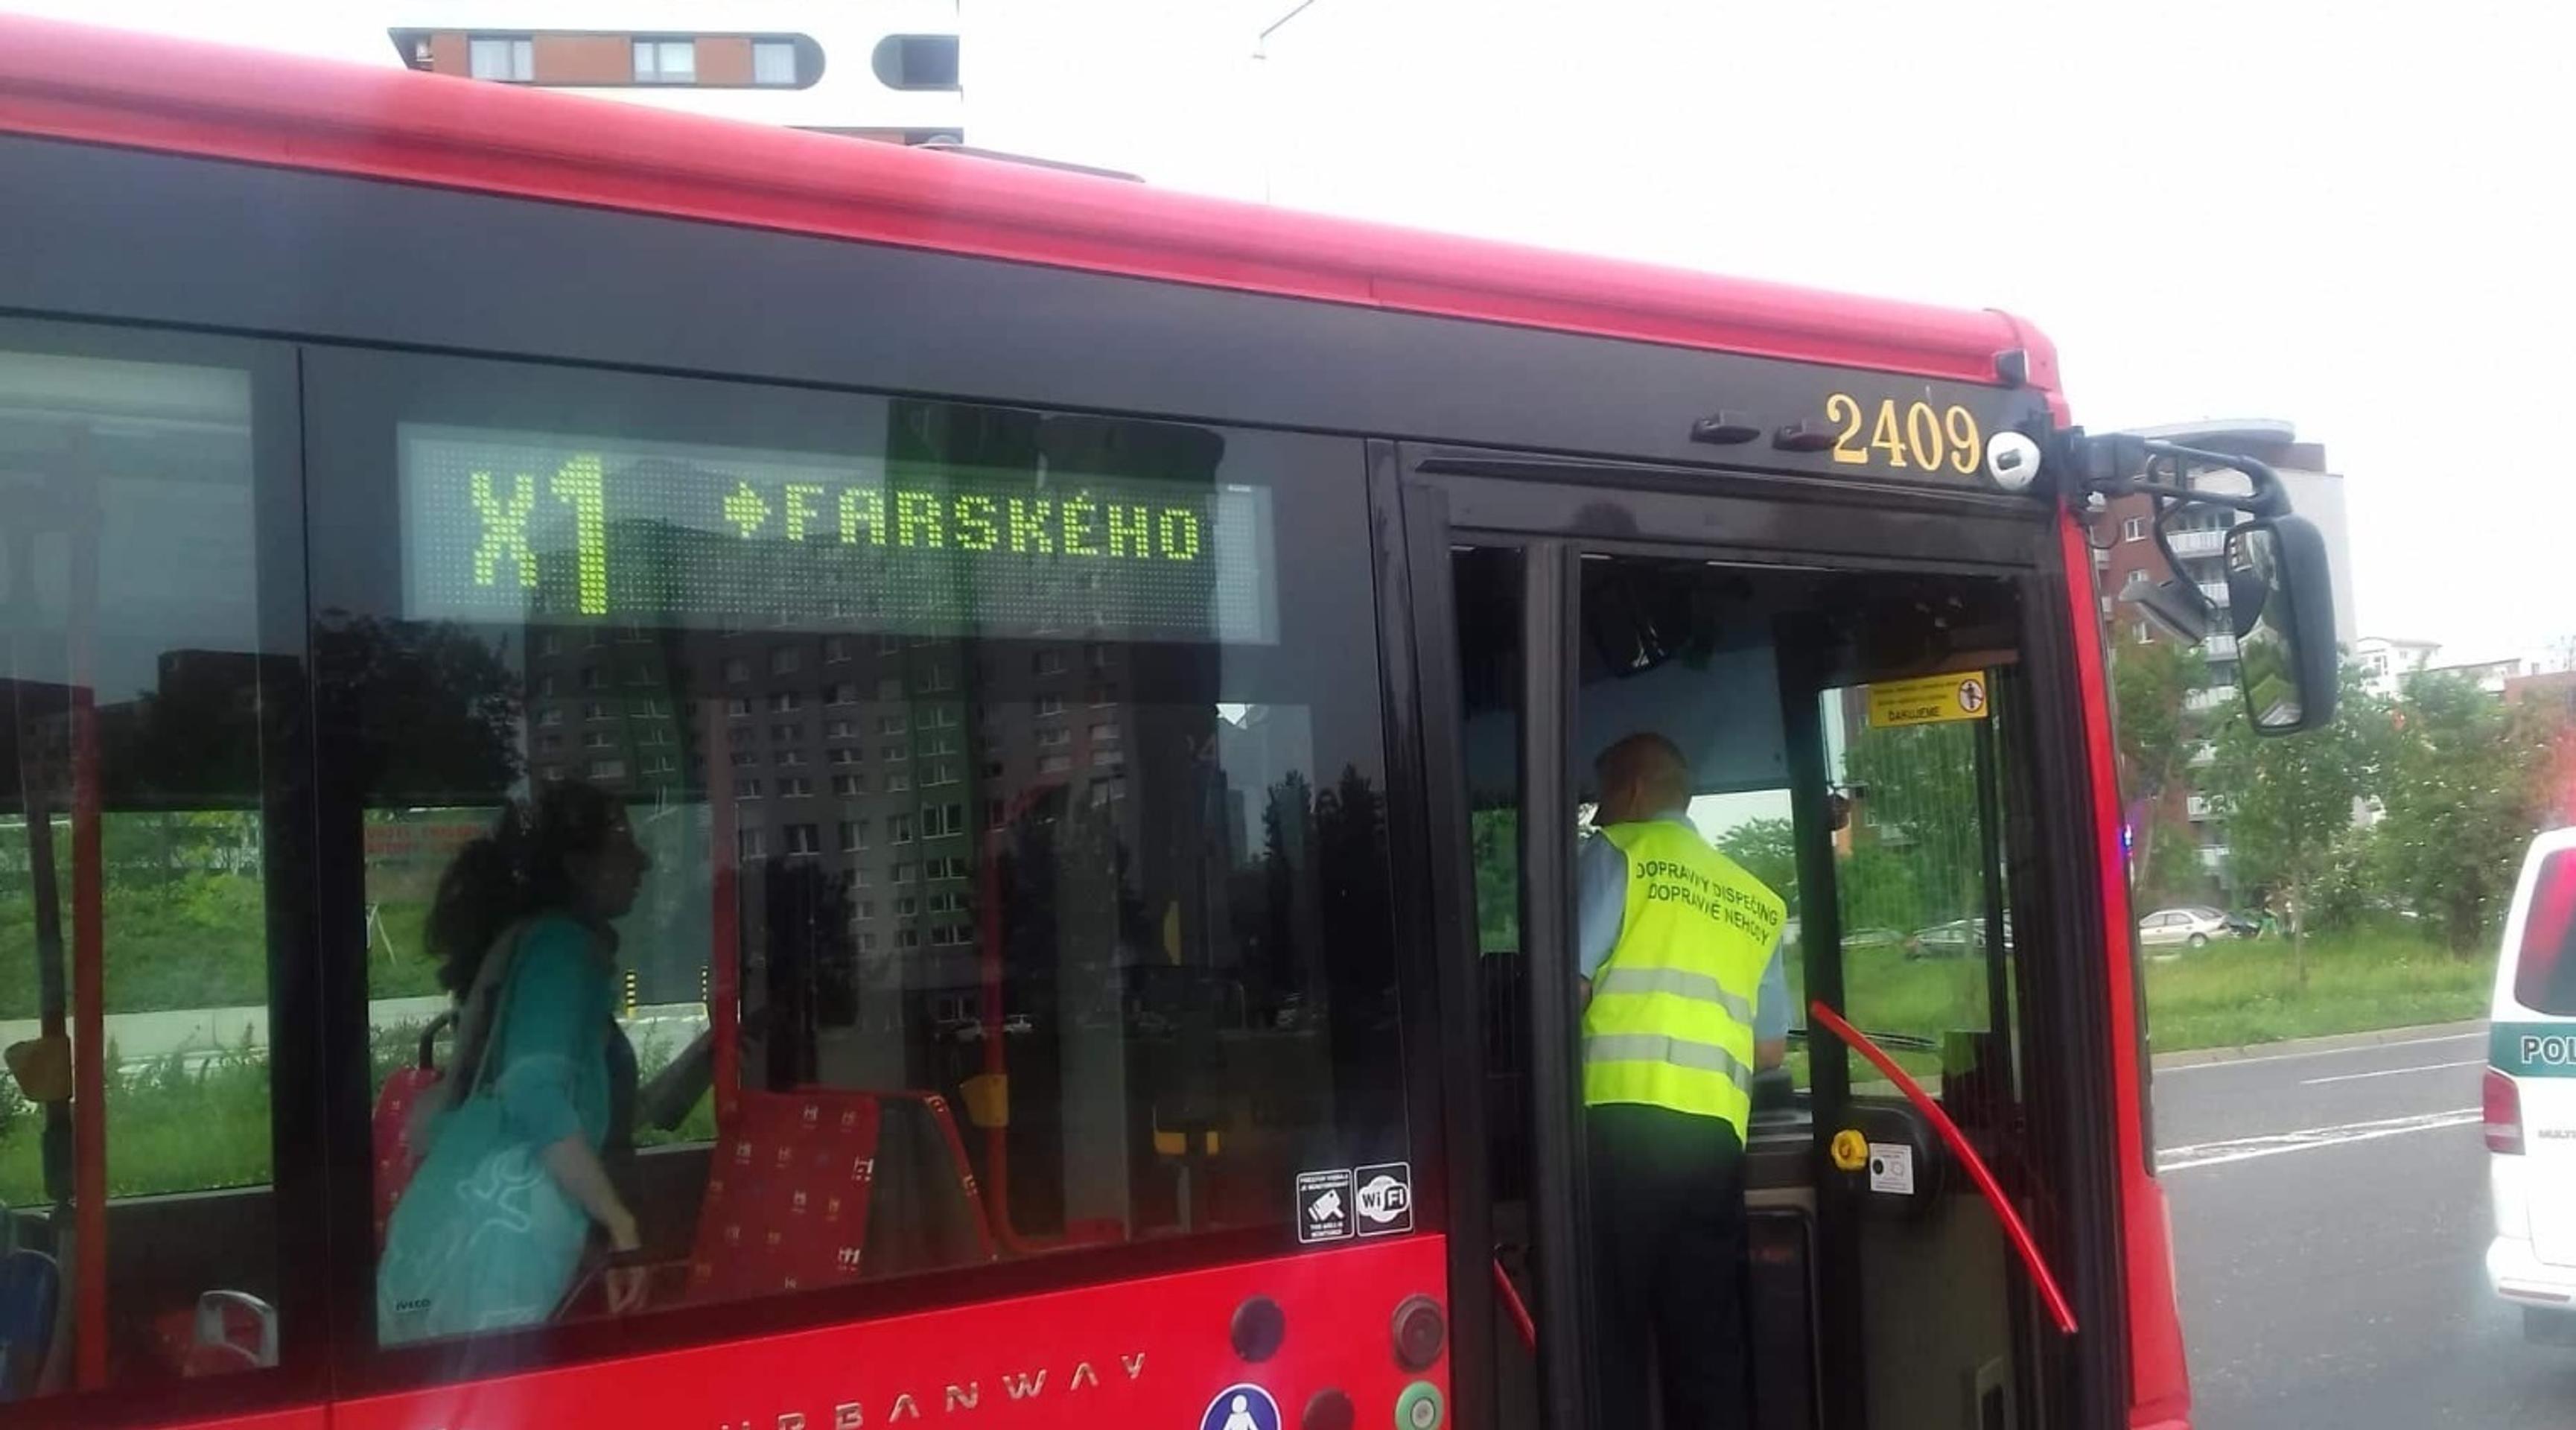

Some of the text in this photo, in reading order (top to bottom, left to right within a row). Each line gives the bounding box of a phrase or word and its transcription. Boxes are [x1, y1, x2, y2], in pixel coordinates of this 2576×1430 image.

[1827, 393, 1981, 474] 2409
[469, 454, 1200, 615] X1 FARSKÉHO
[721, 1352, 1146, 1430] RBANWAY
